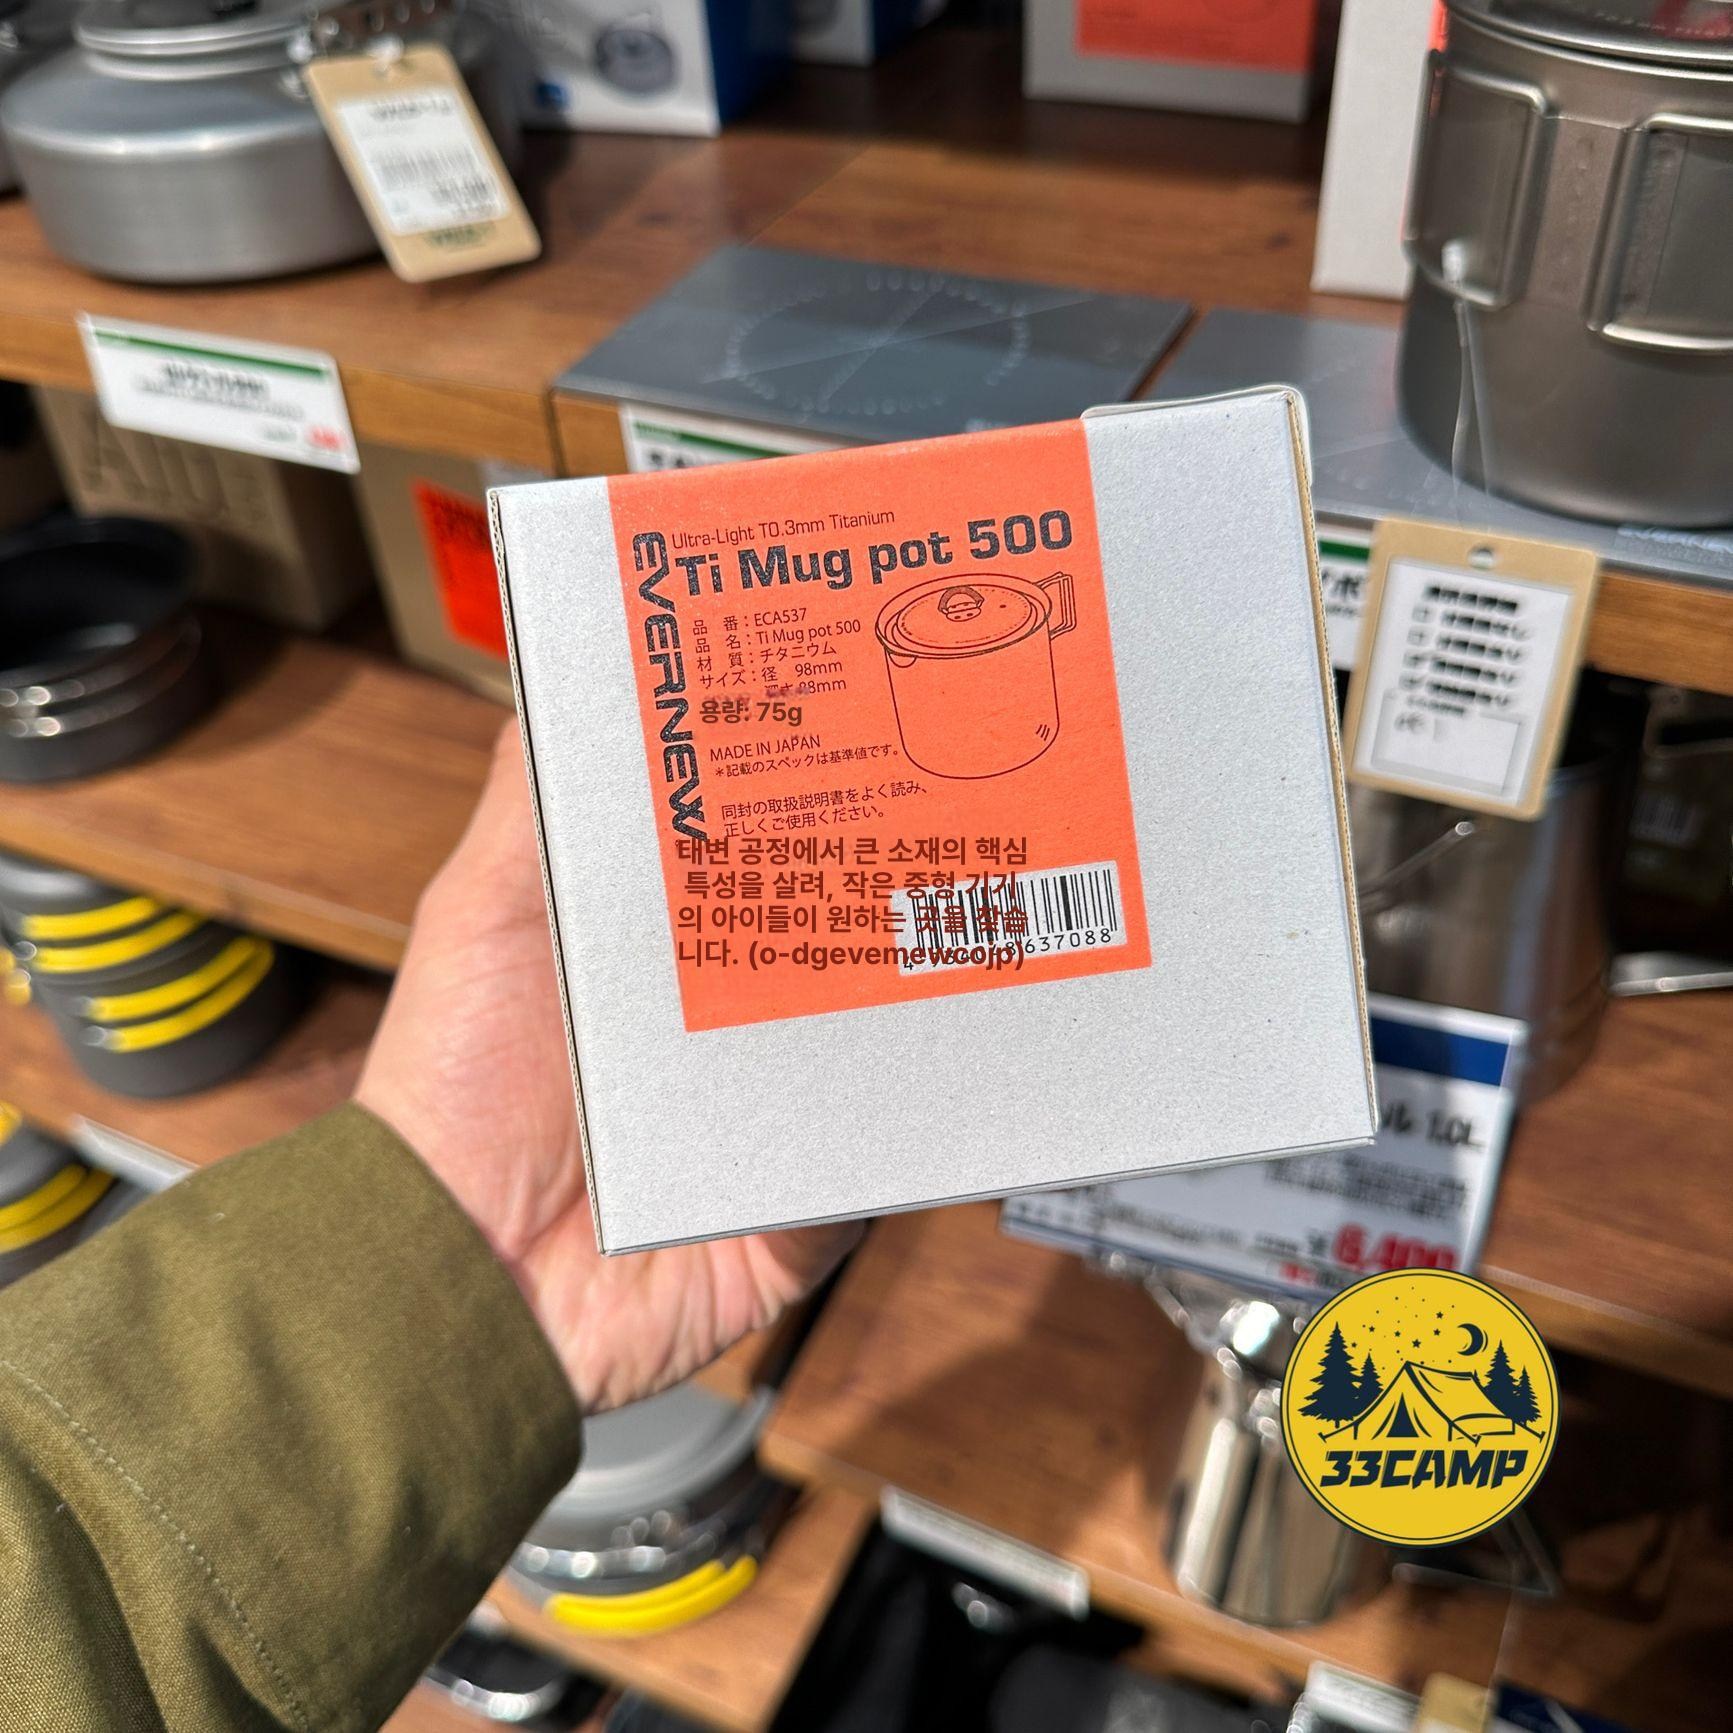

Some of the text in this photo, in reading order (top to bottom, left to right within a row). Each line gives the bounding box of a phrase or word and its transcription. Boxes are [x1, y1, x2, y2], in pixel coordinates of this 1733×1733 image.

[672, 526, 755, 549] Ultra-Light
[828, 511, 895, 530] Titanium
[675, 510, 1073, 597] Ti Mug pot 500
[754, 608, 807, 627] ECA537
[756, 631, 769, 645] Ti
[773, 628, 804, 644] Mug
[808, 625, 832, 639] pot
[836, 619, 861, 635] 500
[795, 661, 843, 677] 98mm
[710, 735, 821, 762] MADE IN JAPAN
